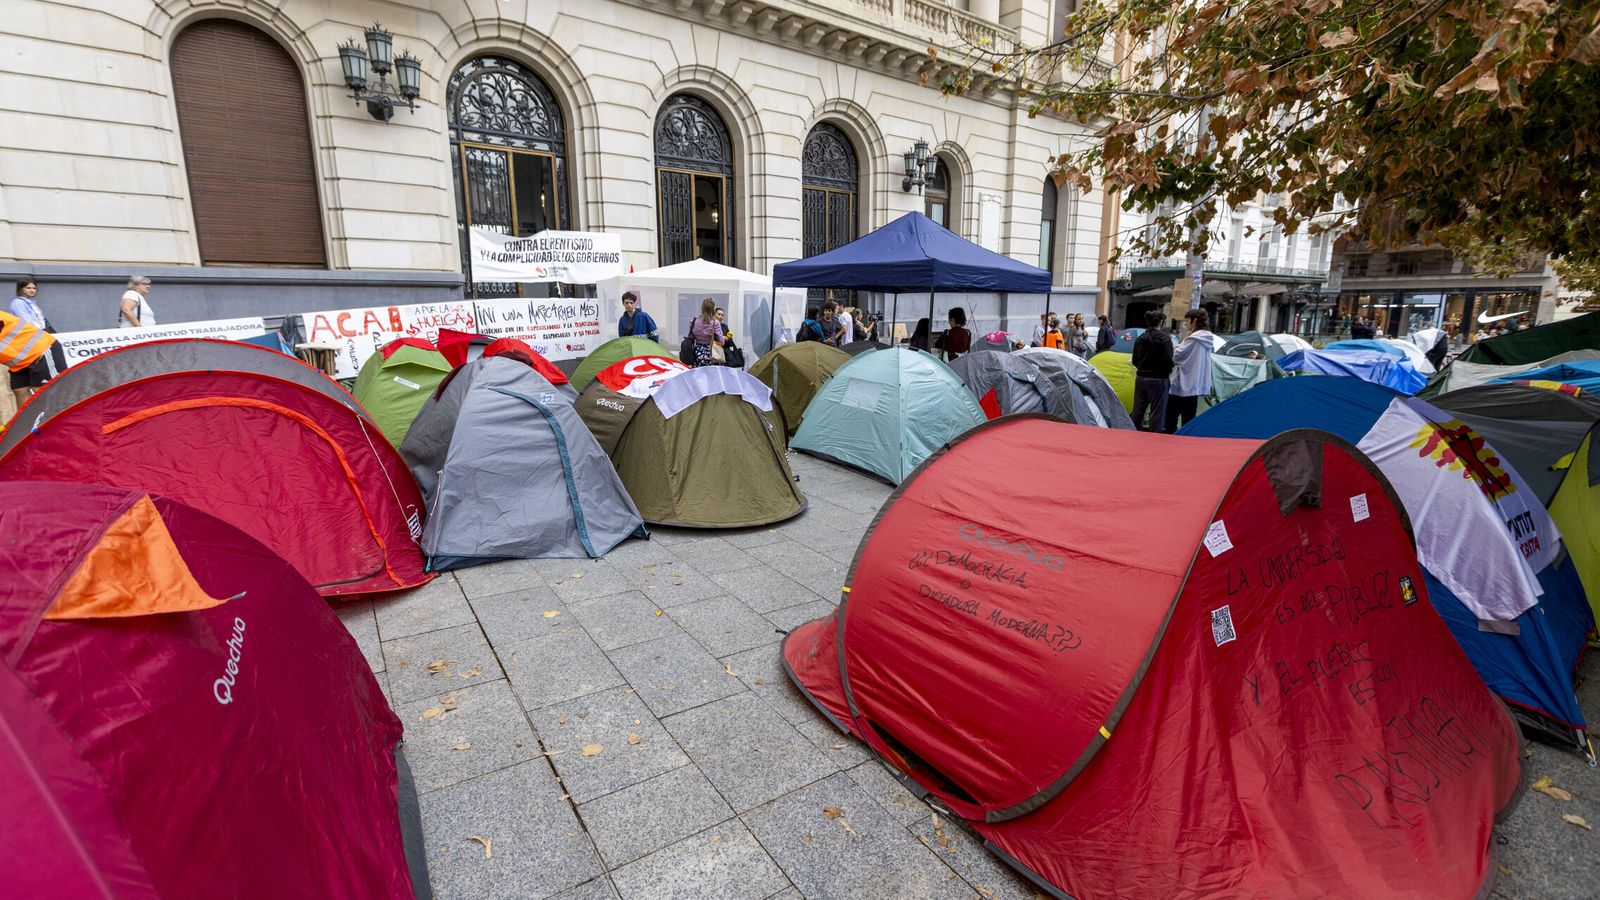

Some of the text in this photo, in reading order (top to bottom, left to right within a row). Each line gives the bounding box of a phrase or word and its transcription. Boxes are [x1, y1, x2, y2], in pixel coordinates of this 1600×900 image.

[504, 238, 593, 252] CONTRA EL RENTISMO
[497, 251, 552, 263] COMPLICIDAD
[576, 251, 620, 263] GOBIERNOS
[439, 304, 450, 313] LA
[502, 309, 523, 322] UNA
[417, 312, 467, 329] HUELGA
[132, 330, 187, 342] JUVENTUD
[189, 323, 263, 335] TRABAJADORA
[596, 397, 625, 411] Quechua
[1227, 568, 1250, 595] LA
[918, 584, 979, 617] DICTADURA
[213, 616, 246, 704] Quechua
[1243, 674, 1261, 707] Y
